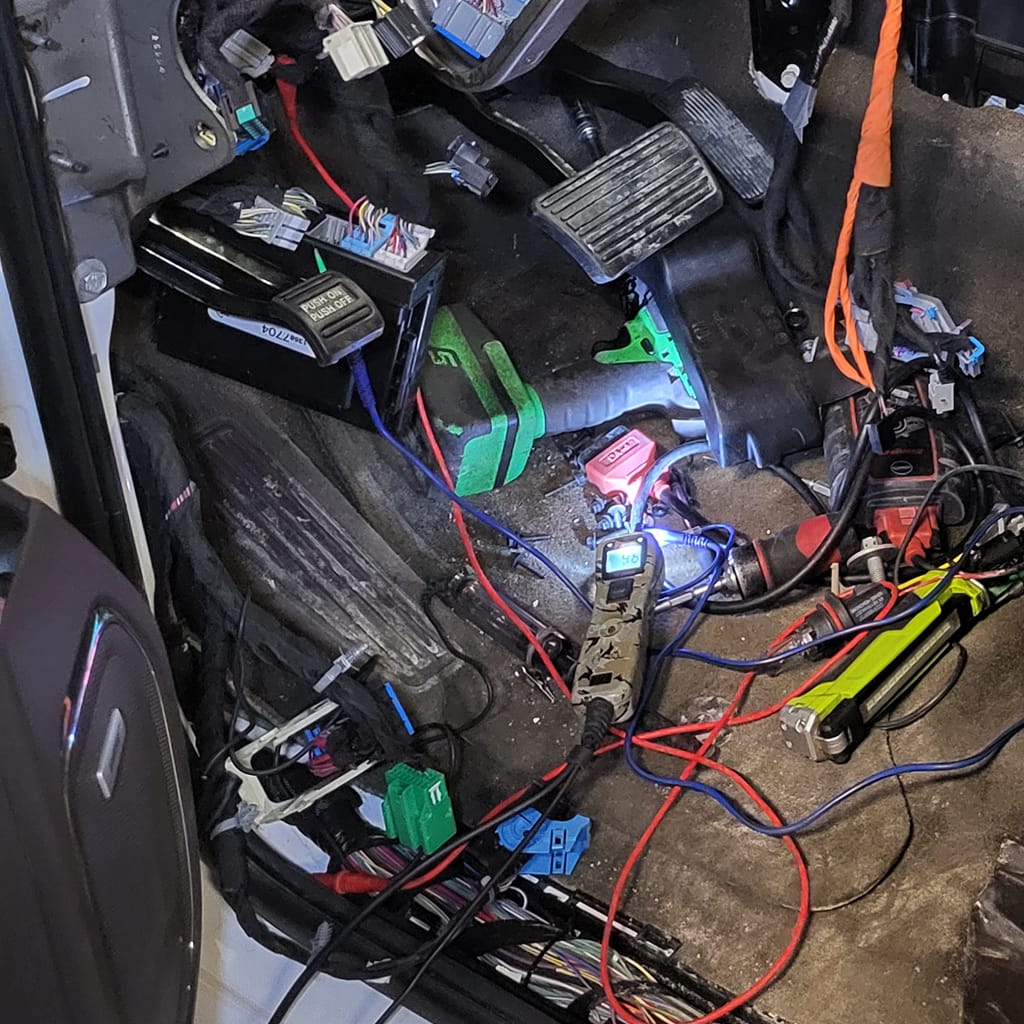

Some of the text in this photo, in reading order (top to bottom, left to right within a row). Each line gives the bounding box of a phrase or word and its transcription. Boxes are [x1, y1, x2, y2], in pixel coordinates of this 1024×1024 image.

[300, 286, 344, 314] PUSH ON
[310, 294, 354, 322] PUSH OFF
